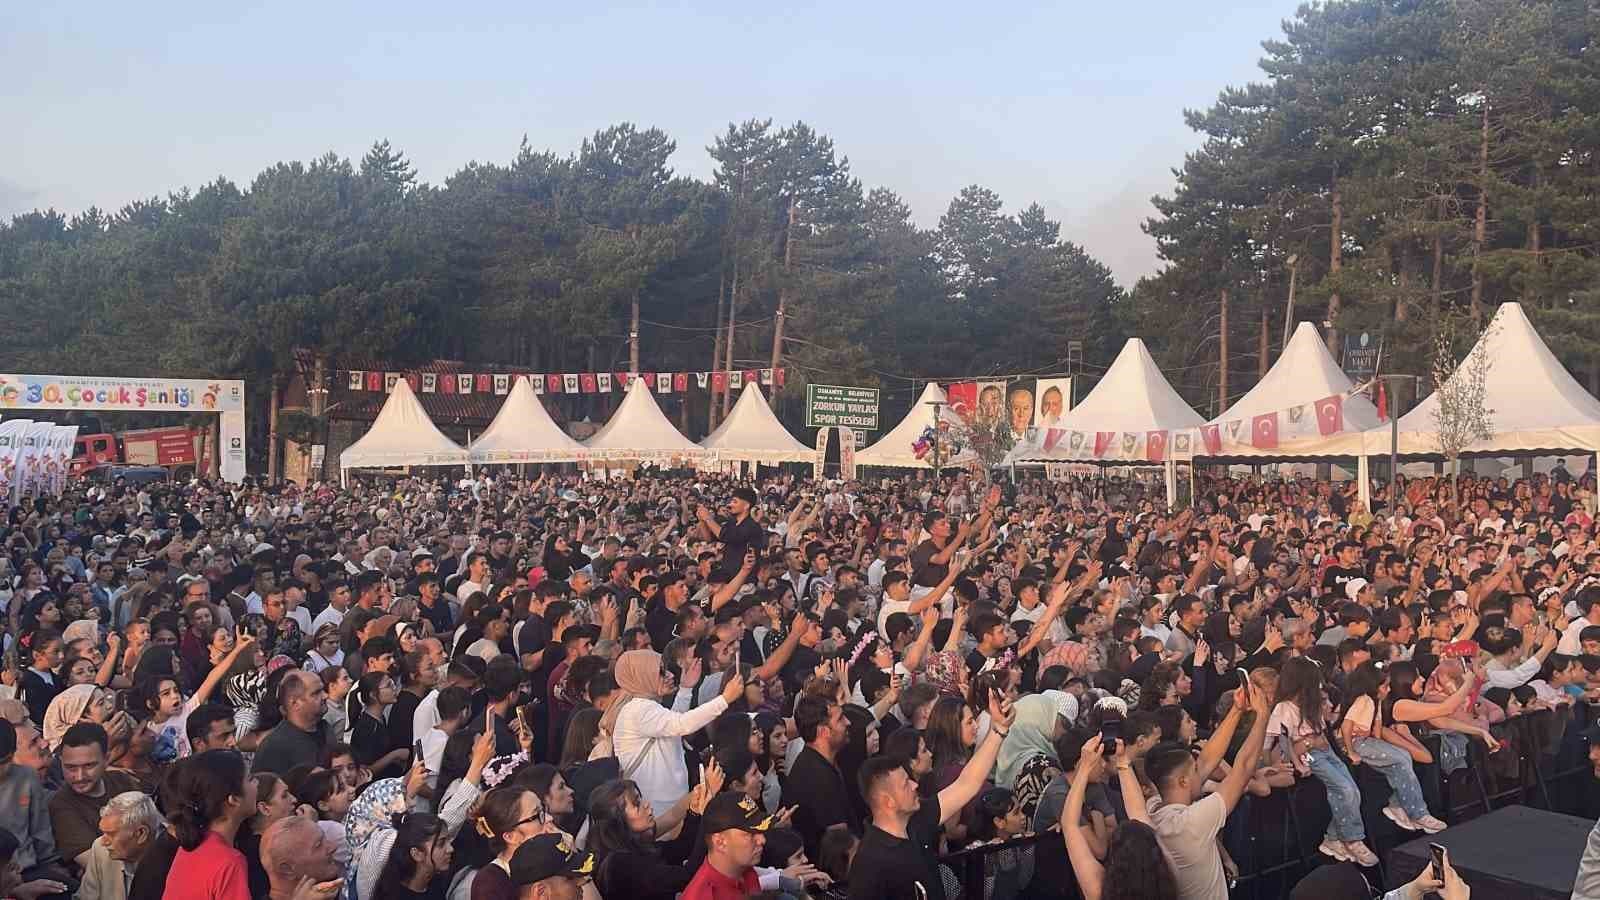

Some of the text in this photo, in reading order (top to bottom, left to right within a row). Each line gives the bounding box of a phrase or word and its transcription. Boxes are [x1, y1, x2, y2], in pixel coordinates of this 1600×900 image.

[26, 383, 195, 408] 30. Çocuk Şenliği
[813, 401, 879, 413] ZORKUN YAYLASI
[814, 413, 875, 426] SPOR TESİSLERİ
